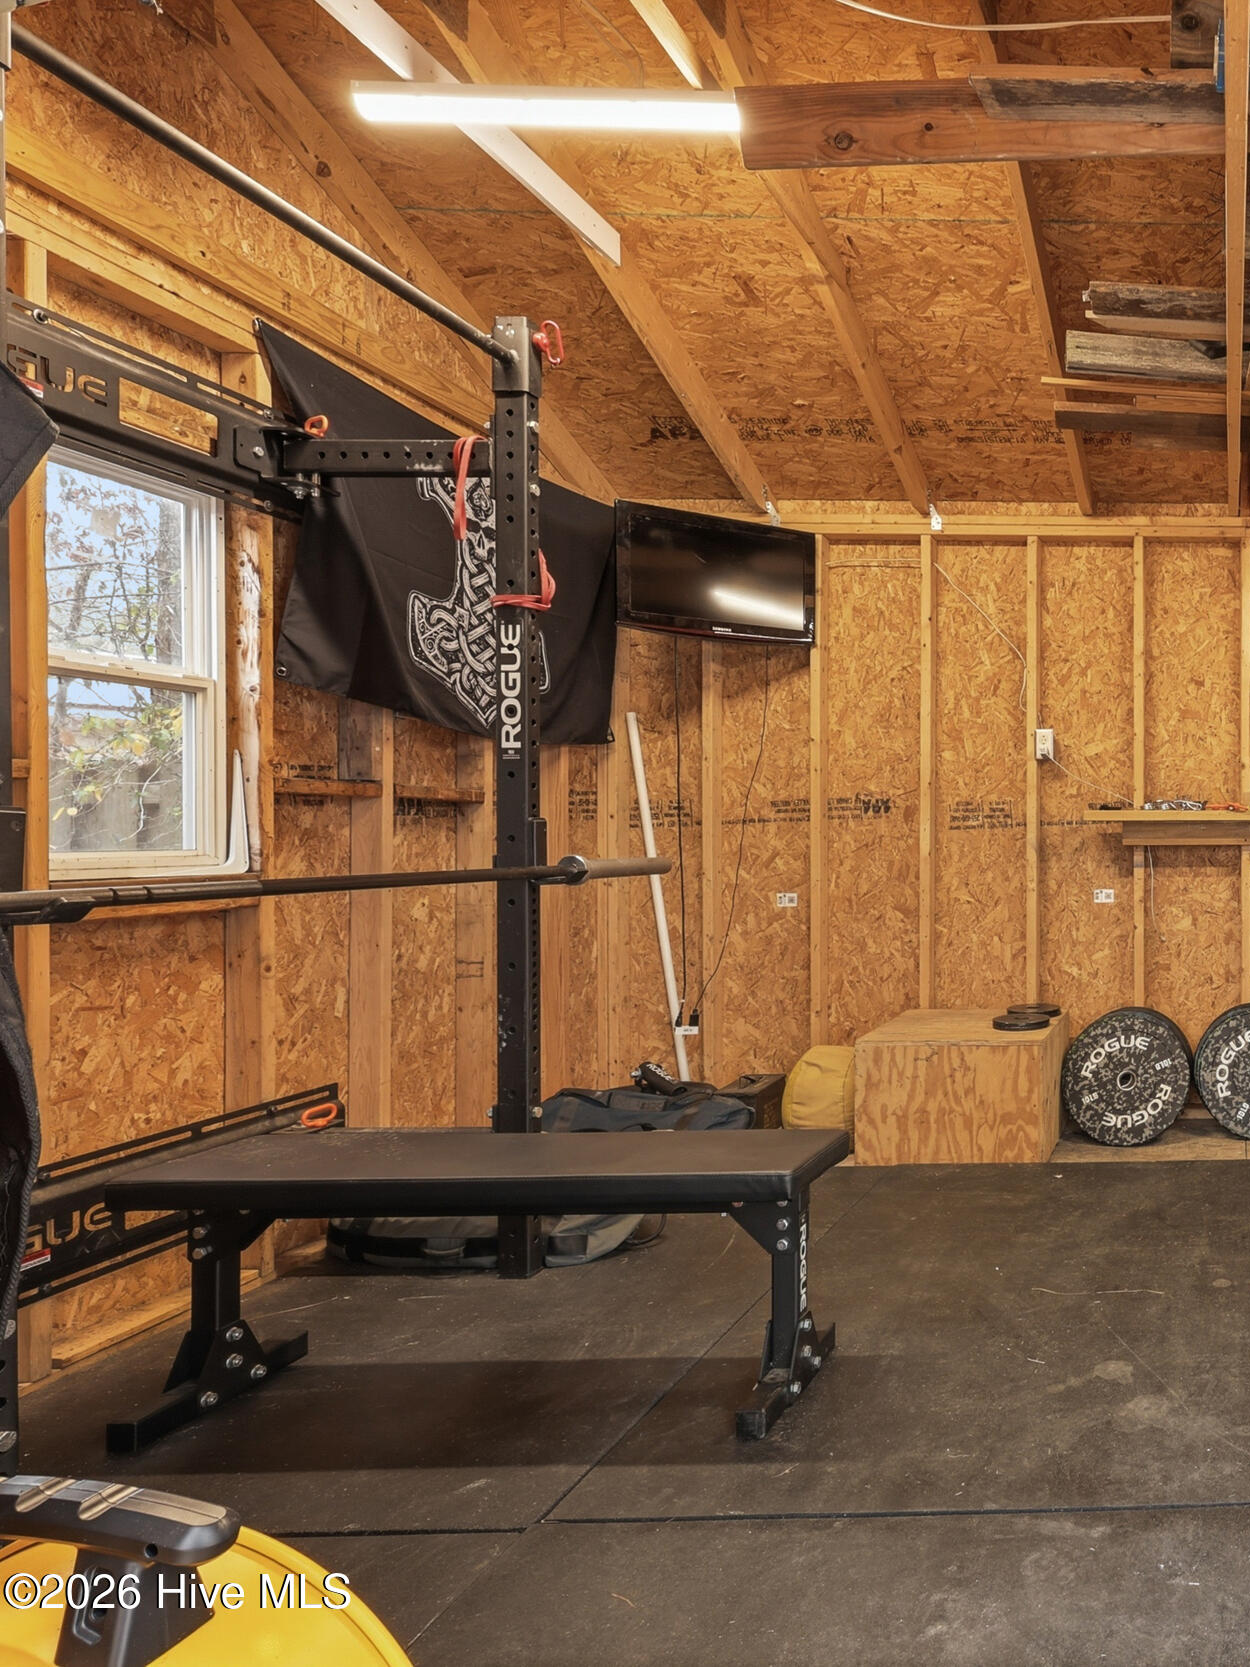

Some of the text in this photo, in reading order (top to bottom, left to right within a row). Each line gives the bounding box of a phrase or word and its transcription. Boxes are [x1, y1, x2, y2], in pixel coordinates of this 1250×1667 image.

[7, 343, 108, 407] GUE
[500, 624, 522, 749] ROGUE
[1080, 1035, 1151, 1078] ROGUE
[1101, 1083, 1172, 1128] ROGUE
[25, 1201, 112, 1255] GUE
[799, 1223, 808, 1313] ROGUE
